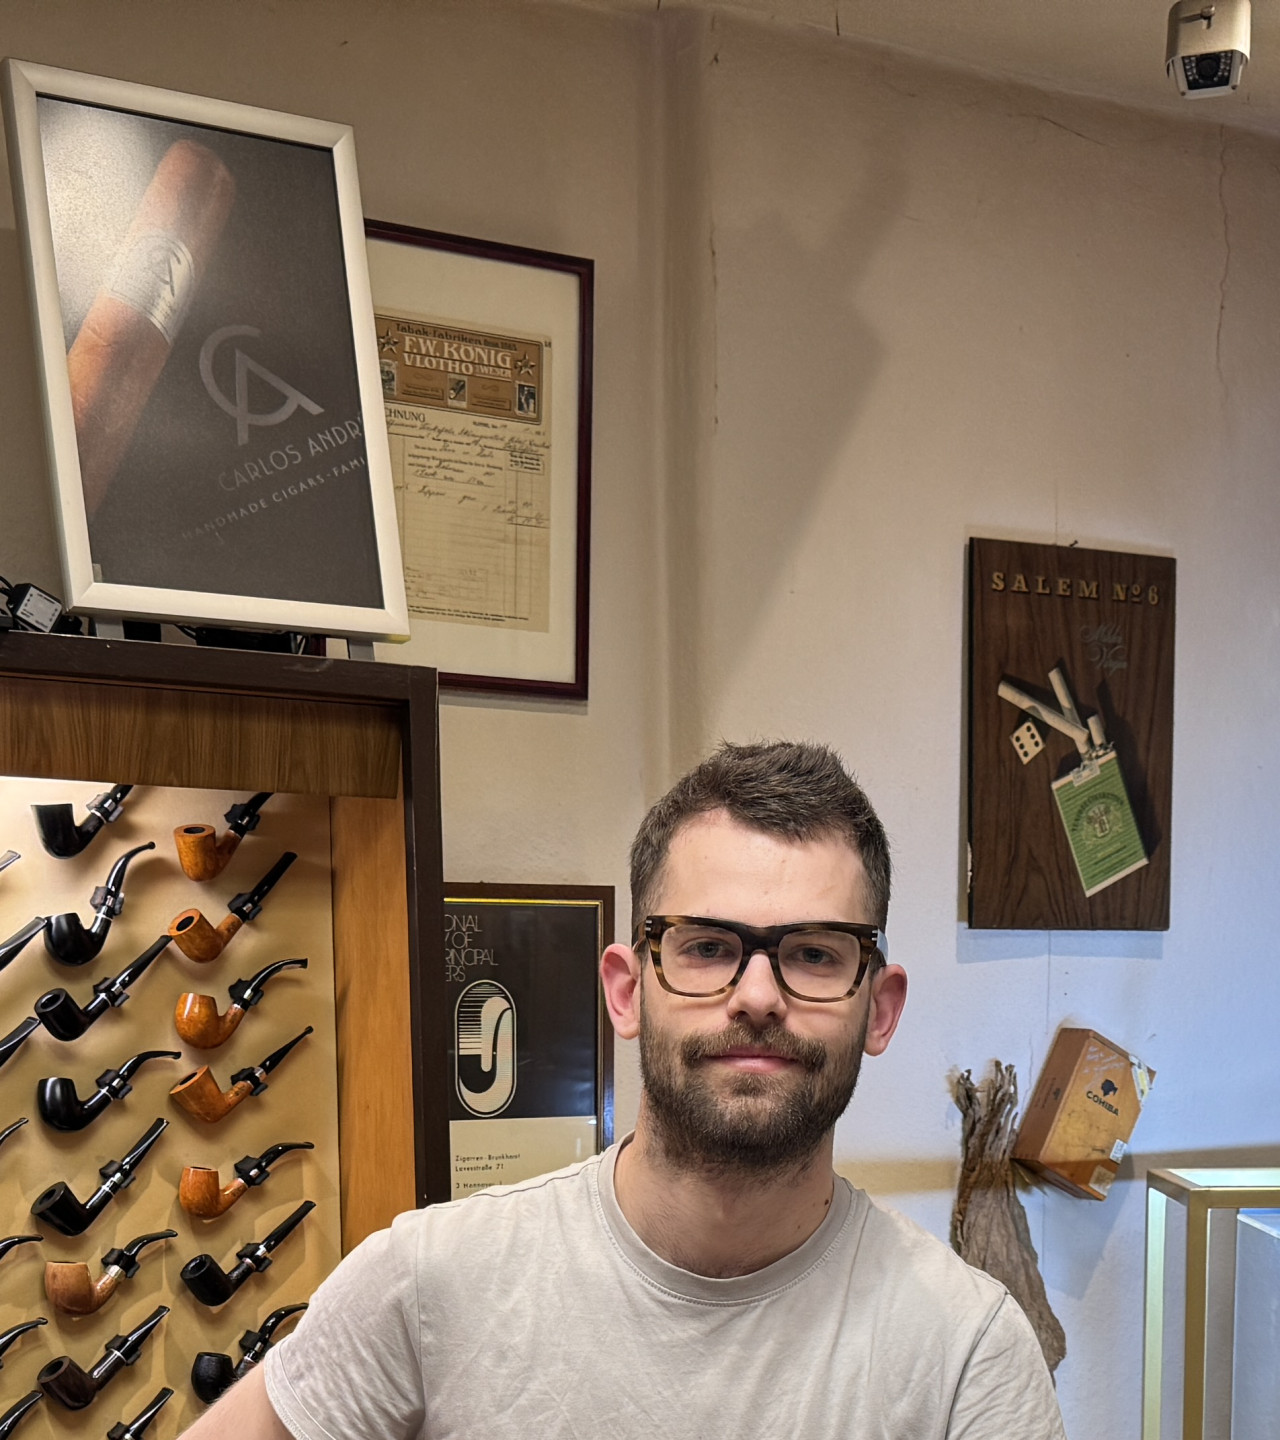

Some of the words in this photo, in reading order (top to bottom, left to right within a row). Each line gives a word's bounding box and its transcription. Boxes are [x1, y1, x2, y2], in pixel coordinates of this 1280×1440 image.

[403, 352, 473, 375] VLOTHO
[219, 444, 302, 491] CARLOS
[308, 417, 363, 456] ANDR
[182, 498, 269, 540] HANDMADE
[991, 571, 1099, 600] SALEM
[1147, 584, 1159, 606] 6
